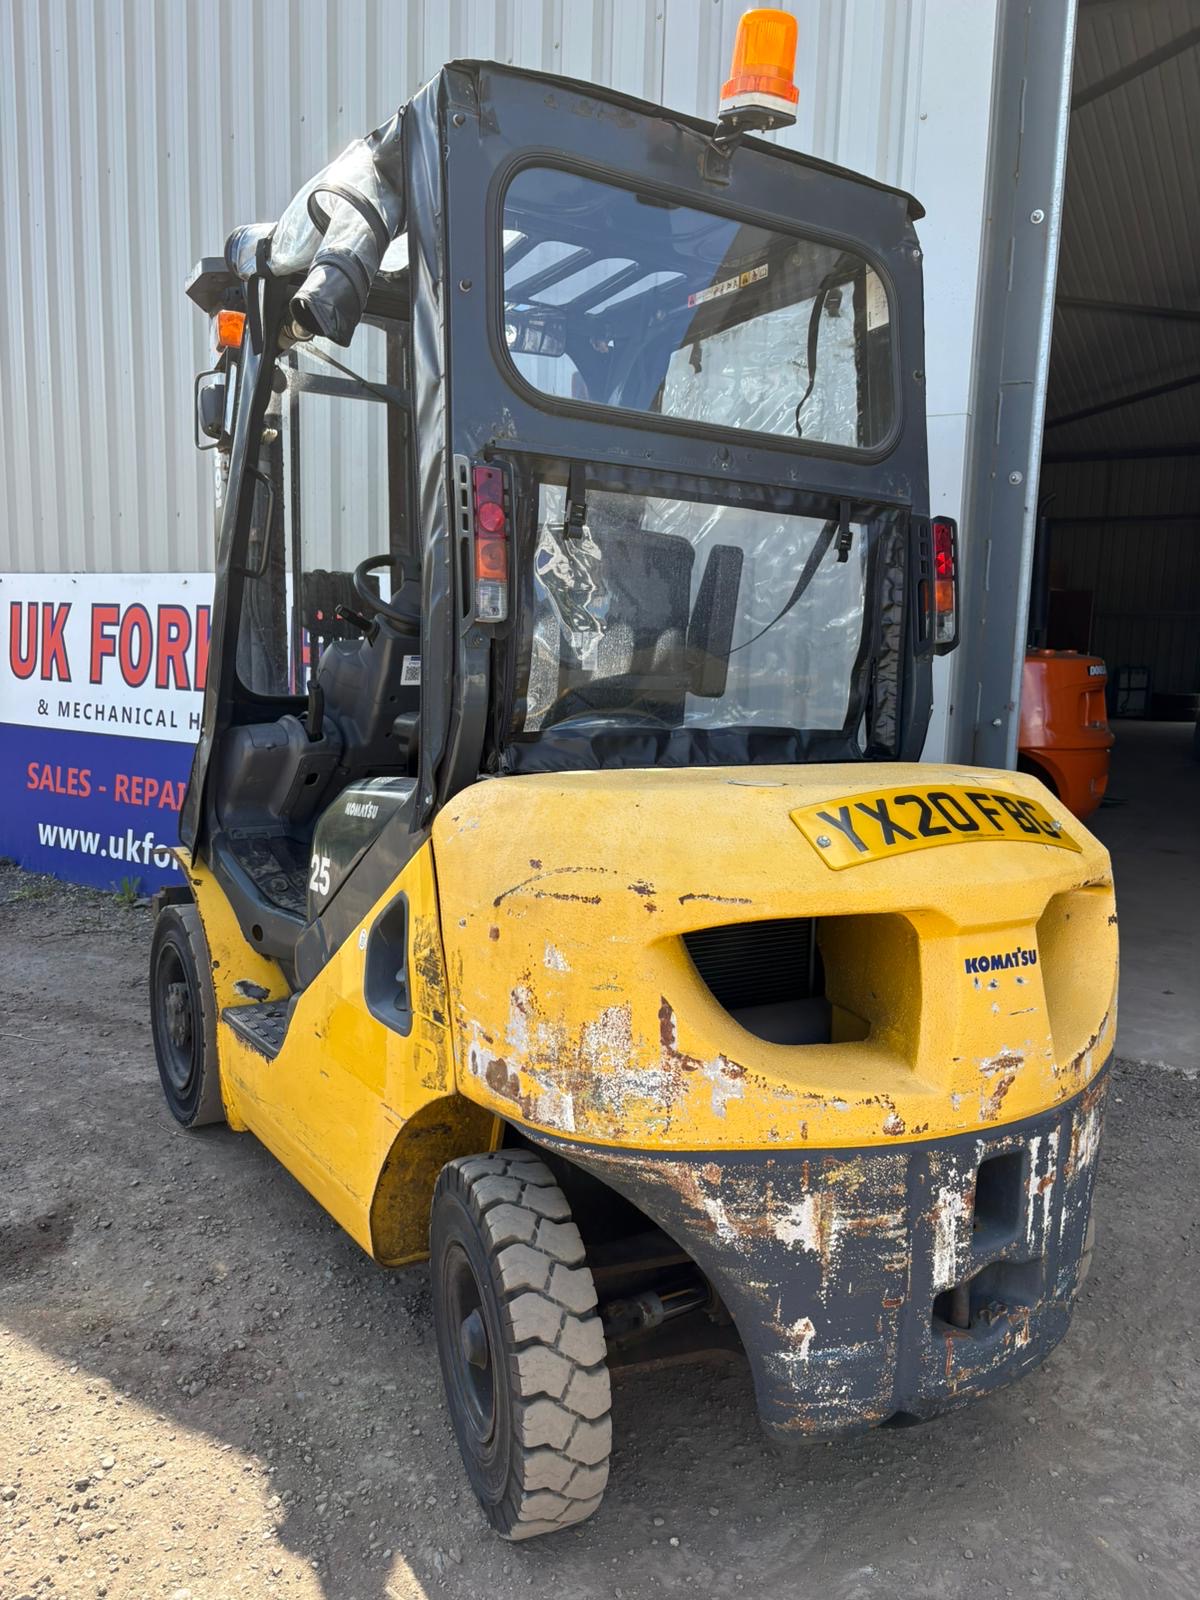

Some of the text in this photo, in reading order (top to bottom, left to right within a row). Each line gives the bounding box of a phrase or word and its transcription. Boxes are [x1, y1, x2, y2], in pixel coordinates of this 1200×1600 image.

[9, 600, 73, 682] UK
[37, 698, 49, 716] &
[57, 700, 178, 729] MECHANICAL
[27, 762, 91, 798] SALES
[344, 801, 379, 819] KOMATSU
[816, 791, 979, 853] YX20
[309, 854, 331, 896] 25
[965, 947, 1037, 974] KOMATSU
